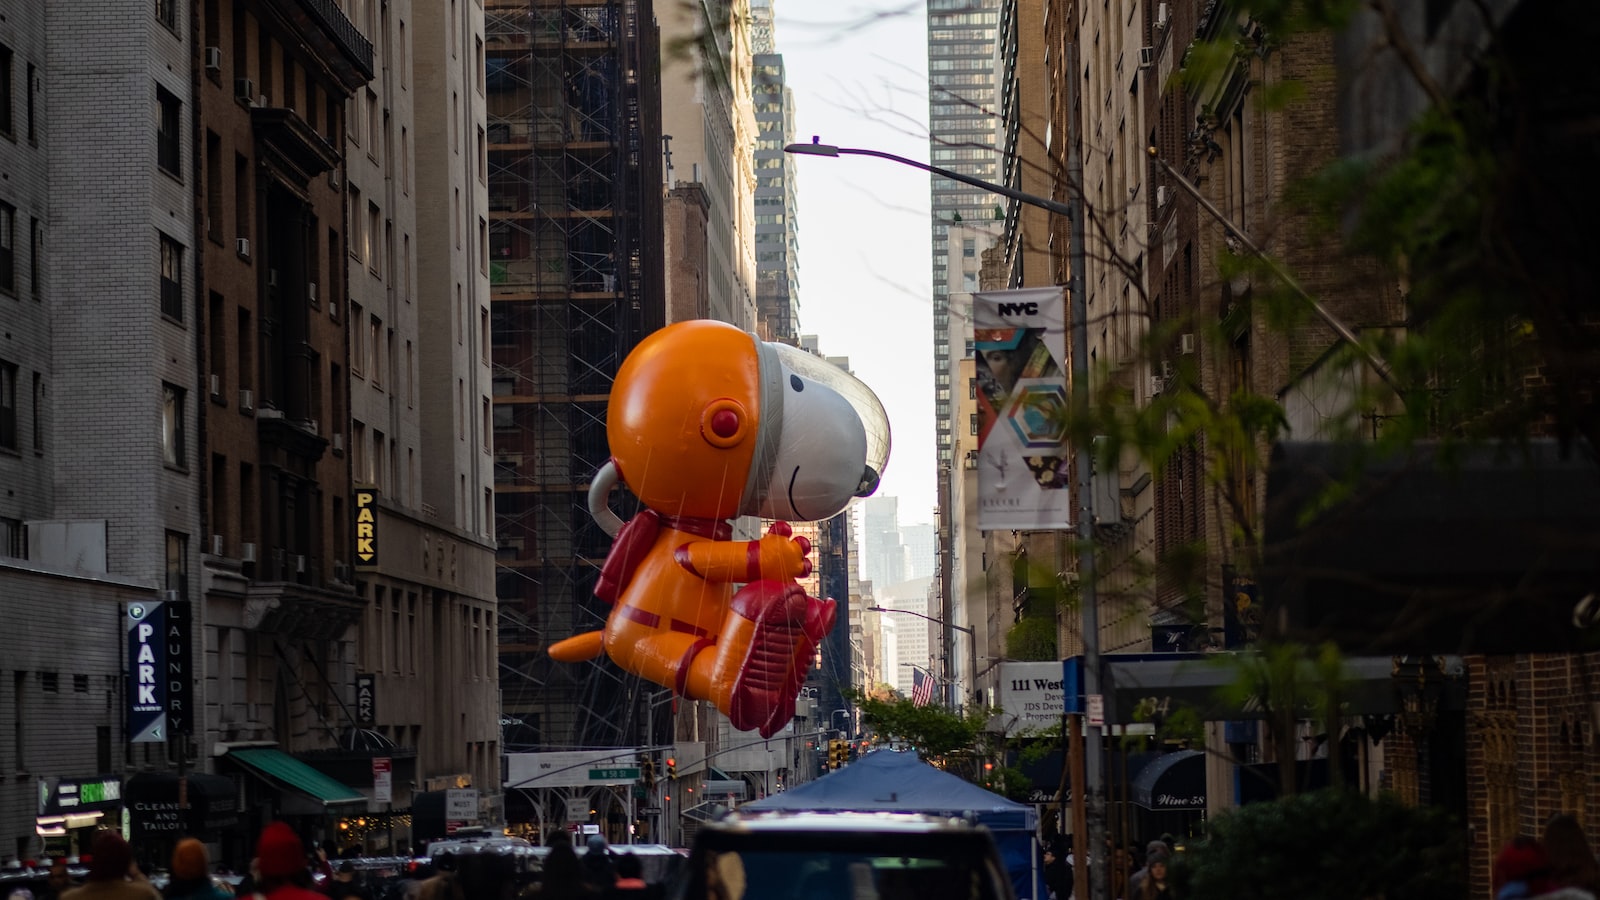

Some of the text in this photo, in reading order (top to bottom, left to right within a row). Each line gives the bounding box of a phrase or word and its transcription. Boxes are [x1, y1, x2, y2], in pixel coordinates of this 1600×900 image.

[998, 302, 1039, 317] NYC
[357, 493, 375, 553] PARK
[138, 622, 156, 705] PARK
[169, 607, 182, 729] LAUNDRY
[1011, 679, 1065, 691] 111 West
[359, 678, 371, 717] PARK
[1024, 703, 1040, 711] JDS
[135, 802, 192, 811] CLEANES
[1190, 795, 1205, 805] 58
[155, 812, 177, 821] AND
